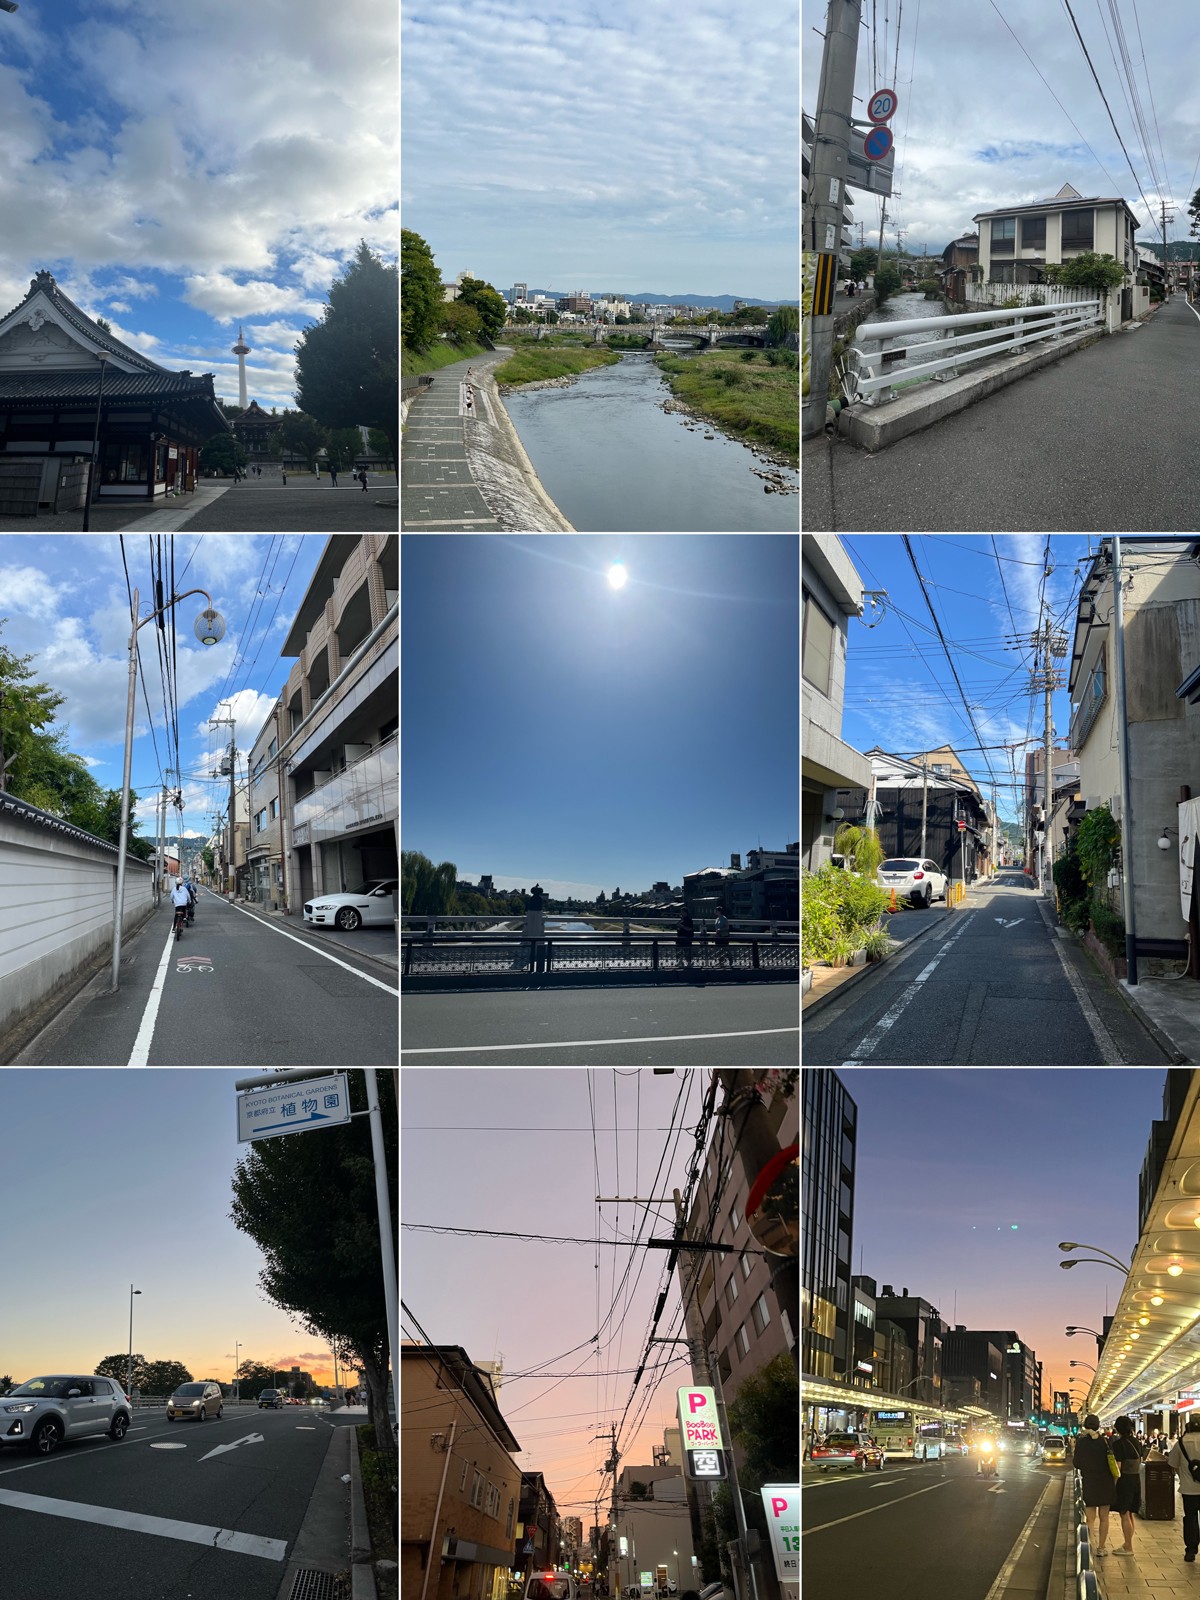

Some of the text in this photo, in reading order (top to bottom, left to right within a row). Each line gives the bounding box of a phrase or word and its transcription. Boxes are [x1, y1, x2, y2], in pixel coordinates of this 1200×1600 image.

[874, 97, 891, 115] 20
[246, 1084, 338, 1108] KYOTO BOTANICAL GARDENS
[246, 1093, 340, 1118] 京都府立 植物園
[688, 1393, 707, 1413] P
[687, 1429, 718, 1440] PARK
[771, 1498, 788, 1517] P
